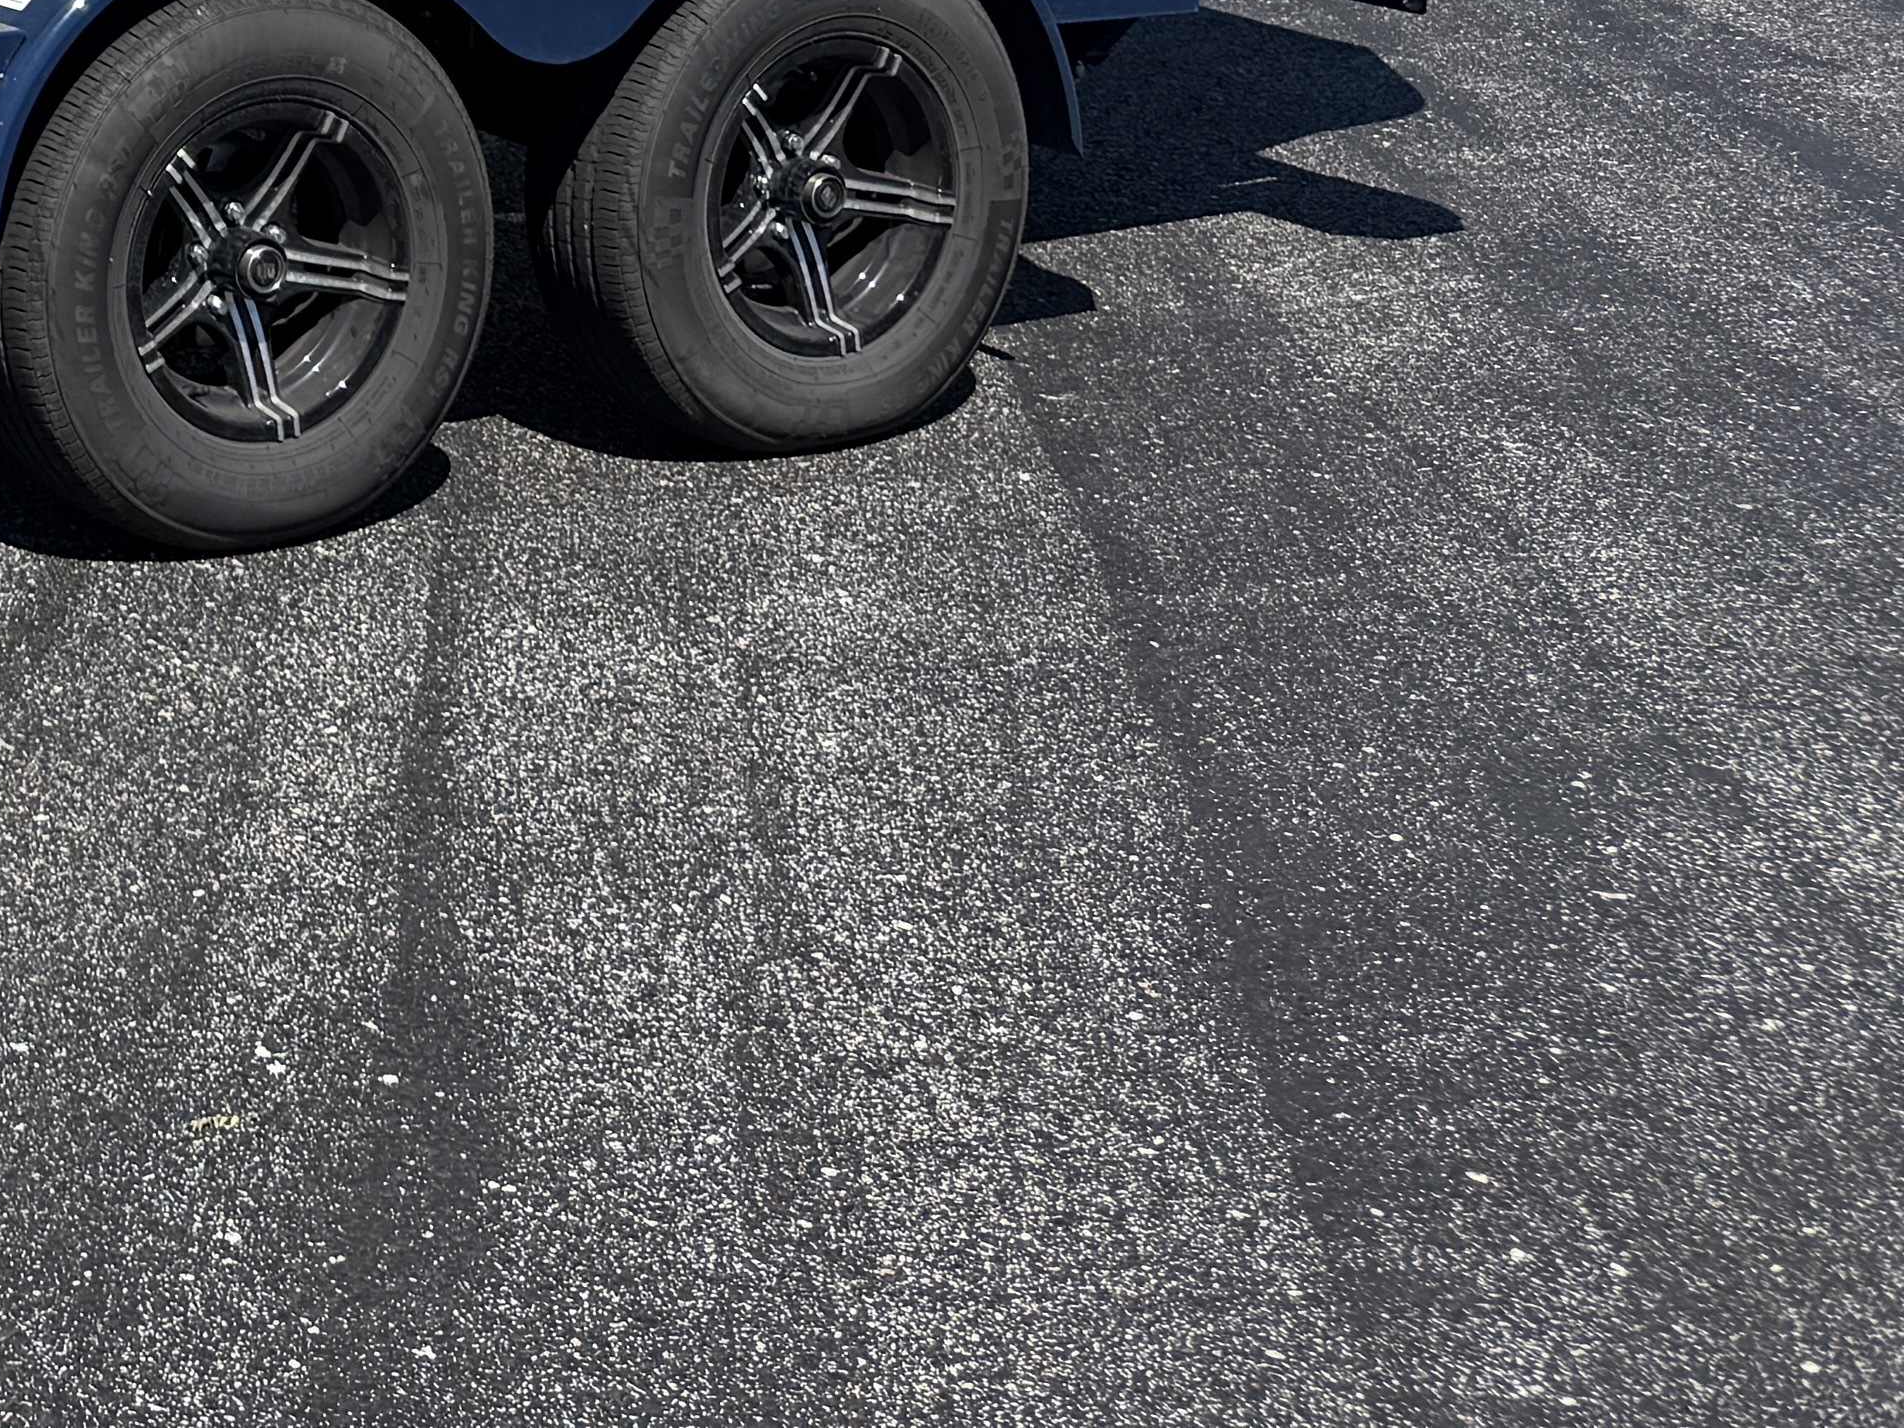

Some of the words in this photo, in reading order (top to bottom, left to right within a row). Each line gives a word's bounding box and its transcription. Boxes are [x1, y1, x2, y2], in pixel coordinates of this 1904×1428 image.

[431, 119, 479, 246] TRAILER
[453, 260, 479, 336] KING
[74, 303, 127, 436] TRAILER
